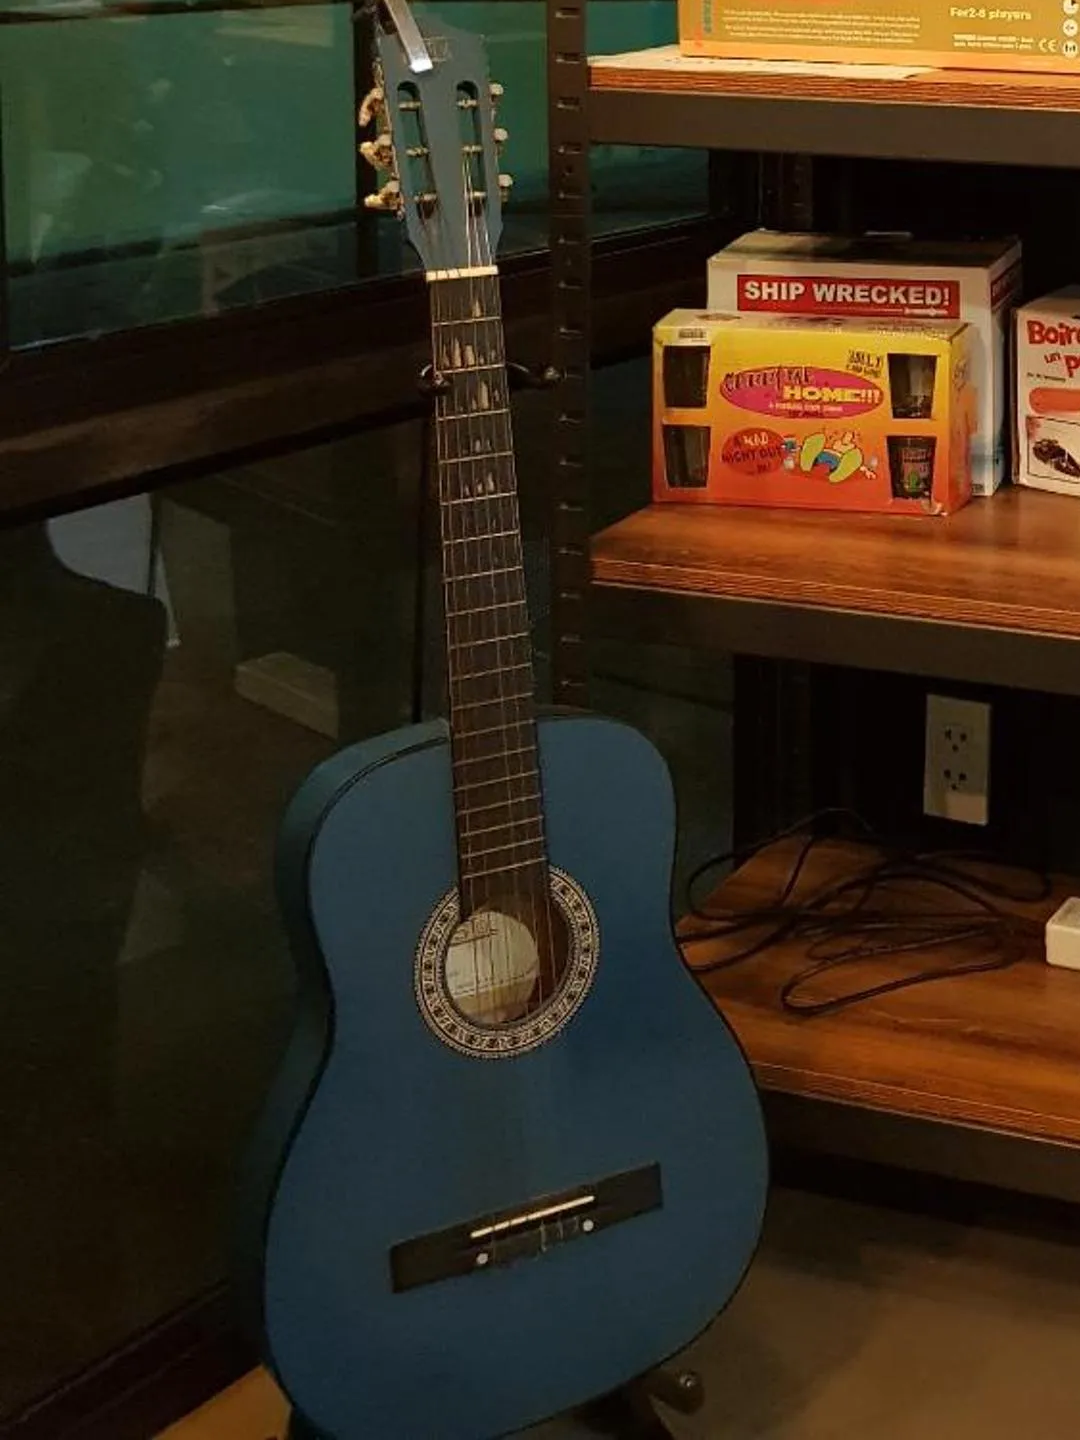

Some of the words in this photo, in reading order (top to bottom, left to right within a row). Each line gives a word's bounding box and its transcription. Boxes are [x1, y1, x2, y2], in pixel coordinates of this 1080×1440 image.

[988, 8, 1033, 22] players
[743, 280, 806, 302] SHIP
[812, 283, 951, 307] WRECKED!
[1044, 351, 1062, 364] un
[782, 385, 881, 404] HOME!!!
